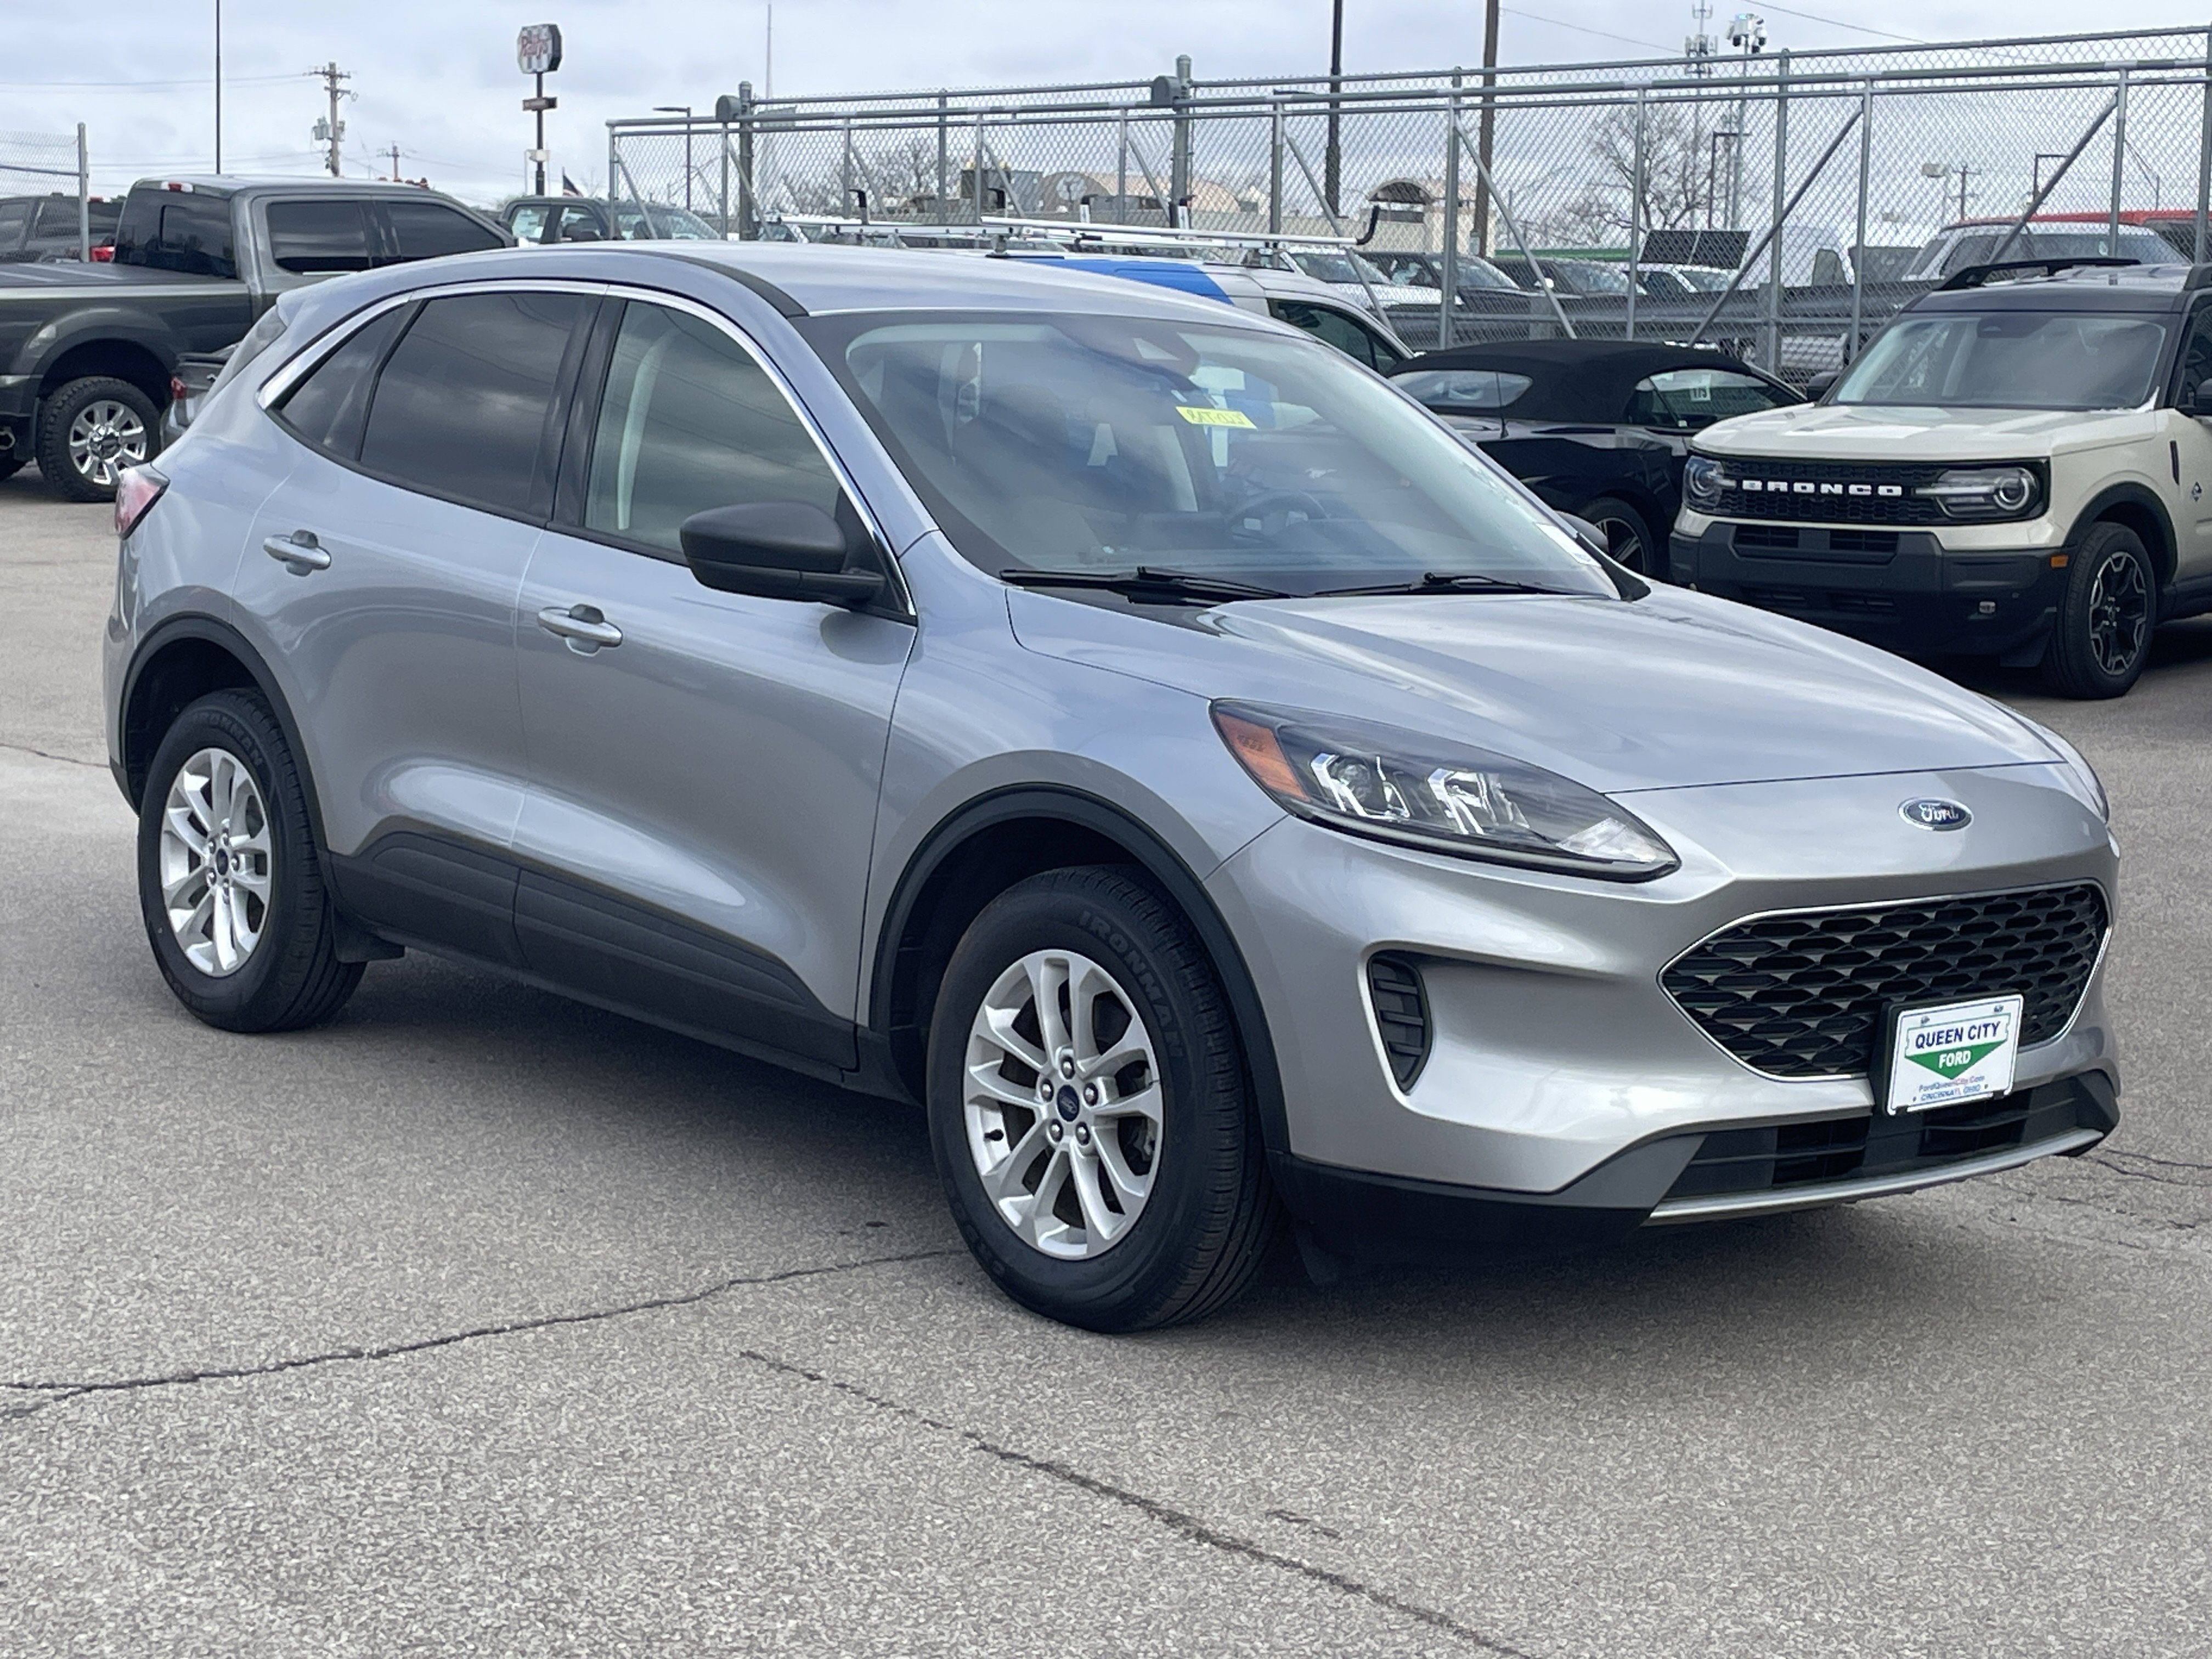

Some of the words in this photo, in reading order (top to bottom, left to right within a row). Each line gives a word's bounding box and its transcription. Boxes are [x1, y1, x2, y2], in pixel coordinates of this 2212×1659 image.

[1742, 479, 1902, 496] BRONCO
[1918, 802, 1959, 822] Ford
[1076, 910, 1184, 1060] IRONMAN
[1915, 1027, 1963, 1049] QUEEN
[1967, 1021, 2001, 1040] CITY
[1938, 1050, 1971, 1069] FORD
